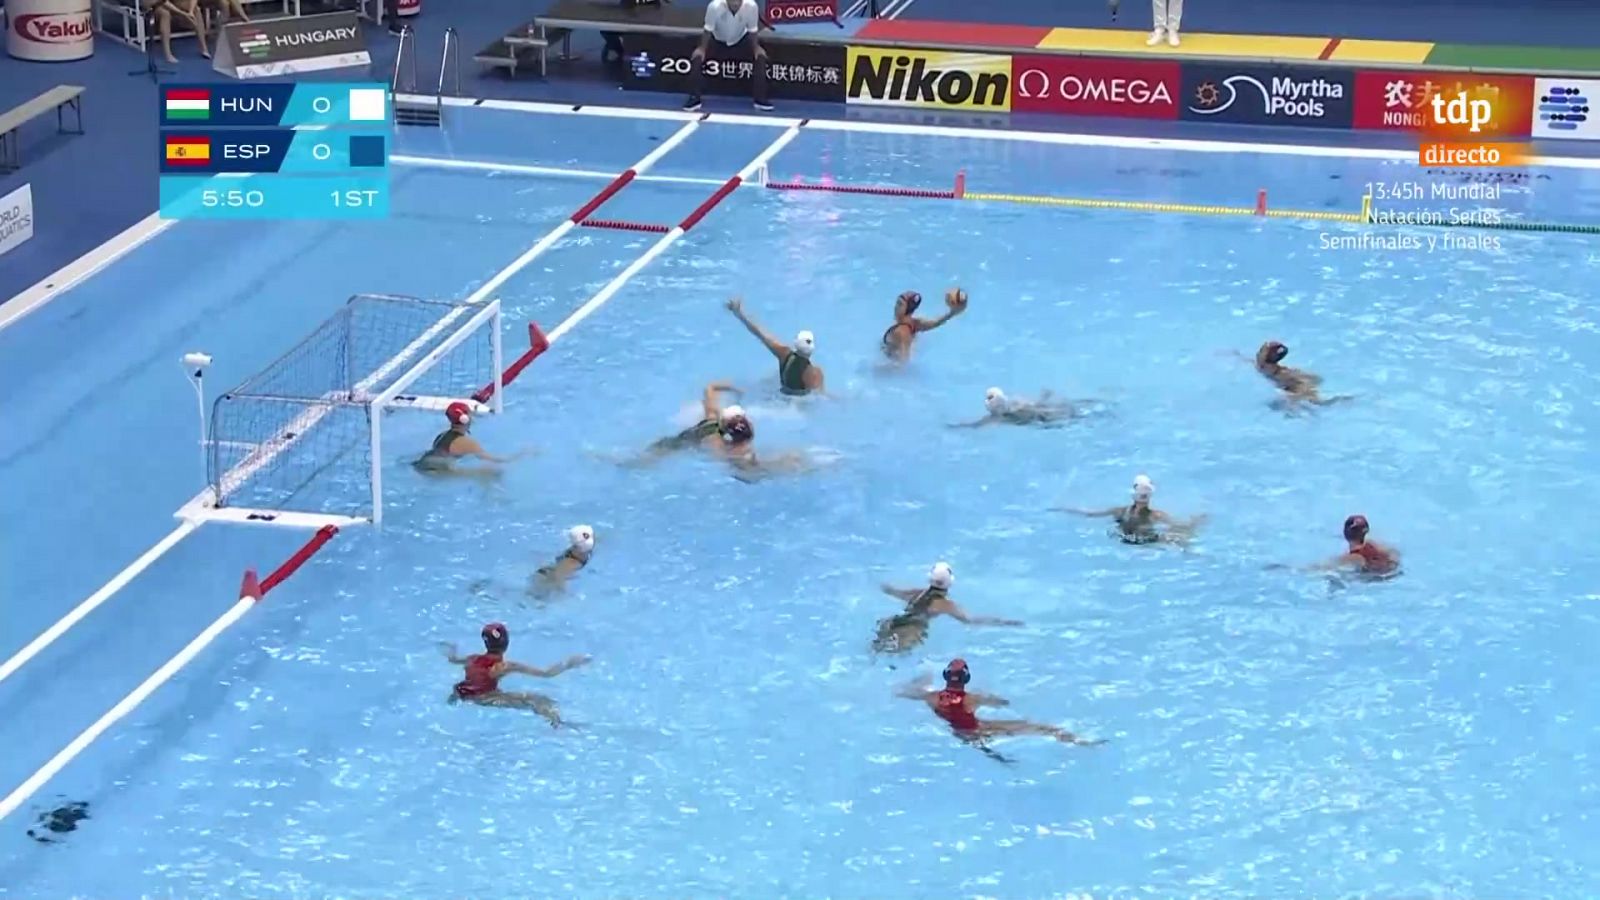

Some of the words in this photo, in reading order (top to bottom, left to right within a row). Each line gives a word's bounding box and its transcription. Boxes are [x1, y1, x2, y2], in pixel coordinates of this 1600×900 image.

[785, 5, 833, 17] OMEGA
[274, 26, 357, 47] HUNGARY
[848, 54, 1010, 106] Nikon
[1059, 77, 1173, 105] OMEGA
[1271, 76, 1343, 100] Myrtha
[1271, 97, 1325, 117] Pools
